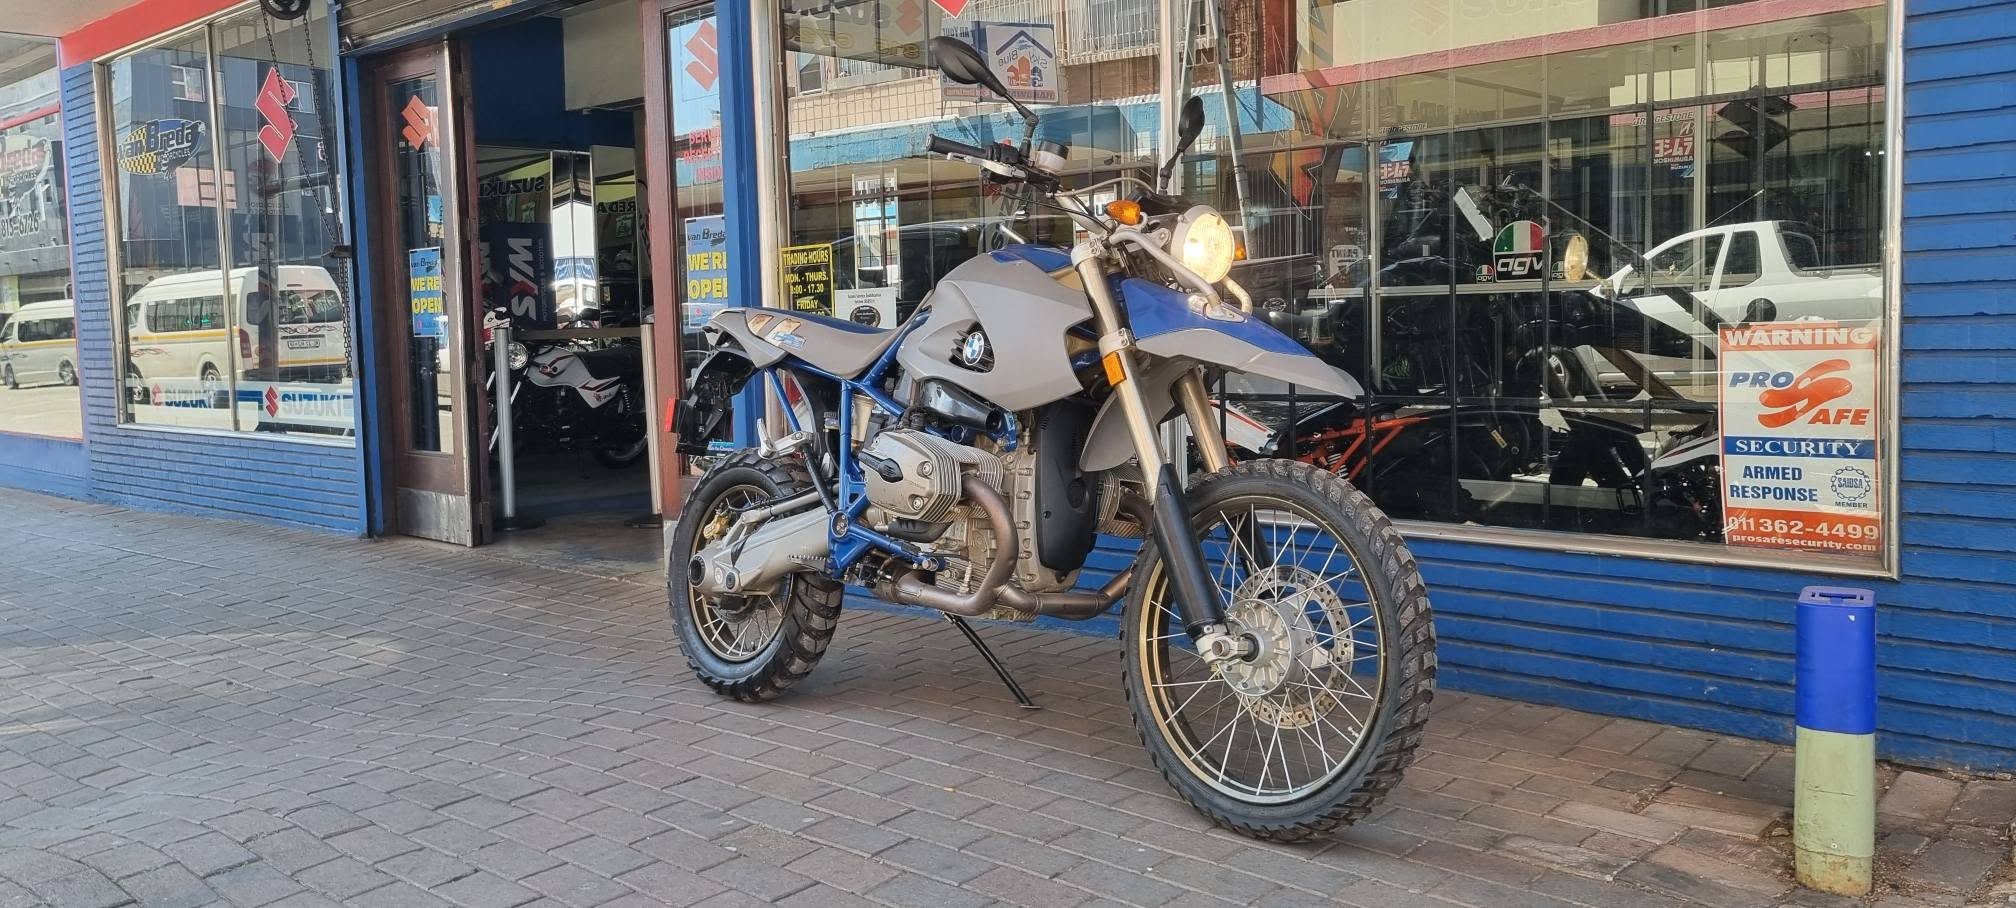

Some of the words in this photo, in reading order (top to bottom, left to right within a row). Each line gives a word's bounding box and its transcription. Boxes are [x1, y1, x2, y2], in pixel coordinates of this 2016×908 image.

[146, 119, 193, 151] Breda
[783, 252, 808, 265] TRADING
[808, 250, 829, 264] HOURS
[784, 273, 800, 283] MON.
[805, 271, 829, 281] THURS.
[807, 283, 824, 293] 17.30
[413, 298, 441, 314] OPEN
[796, 299, 818, 310] FRIDAY
[1725, 328, 1874, 346] WARNING
[1729, 371, 1795, 388] PRO
[281, 392, 342, 417] SUZUKI
[1736, 439, 1862, 456] SECURITY
[1743, 465, 1803, 481] ARMED
[1730, 485, 1818, 502] RESPONSE
[1759, 518, 1879, 540] 362-4499
[1732, 533, 1876, 552] prosafesecurity.com
